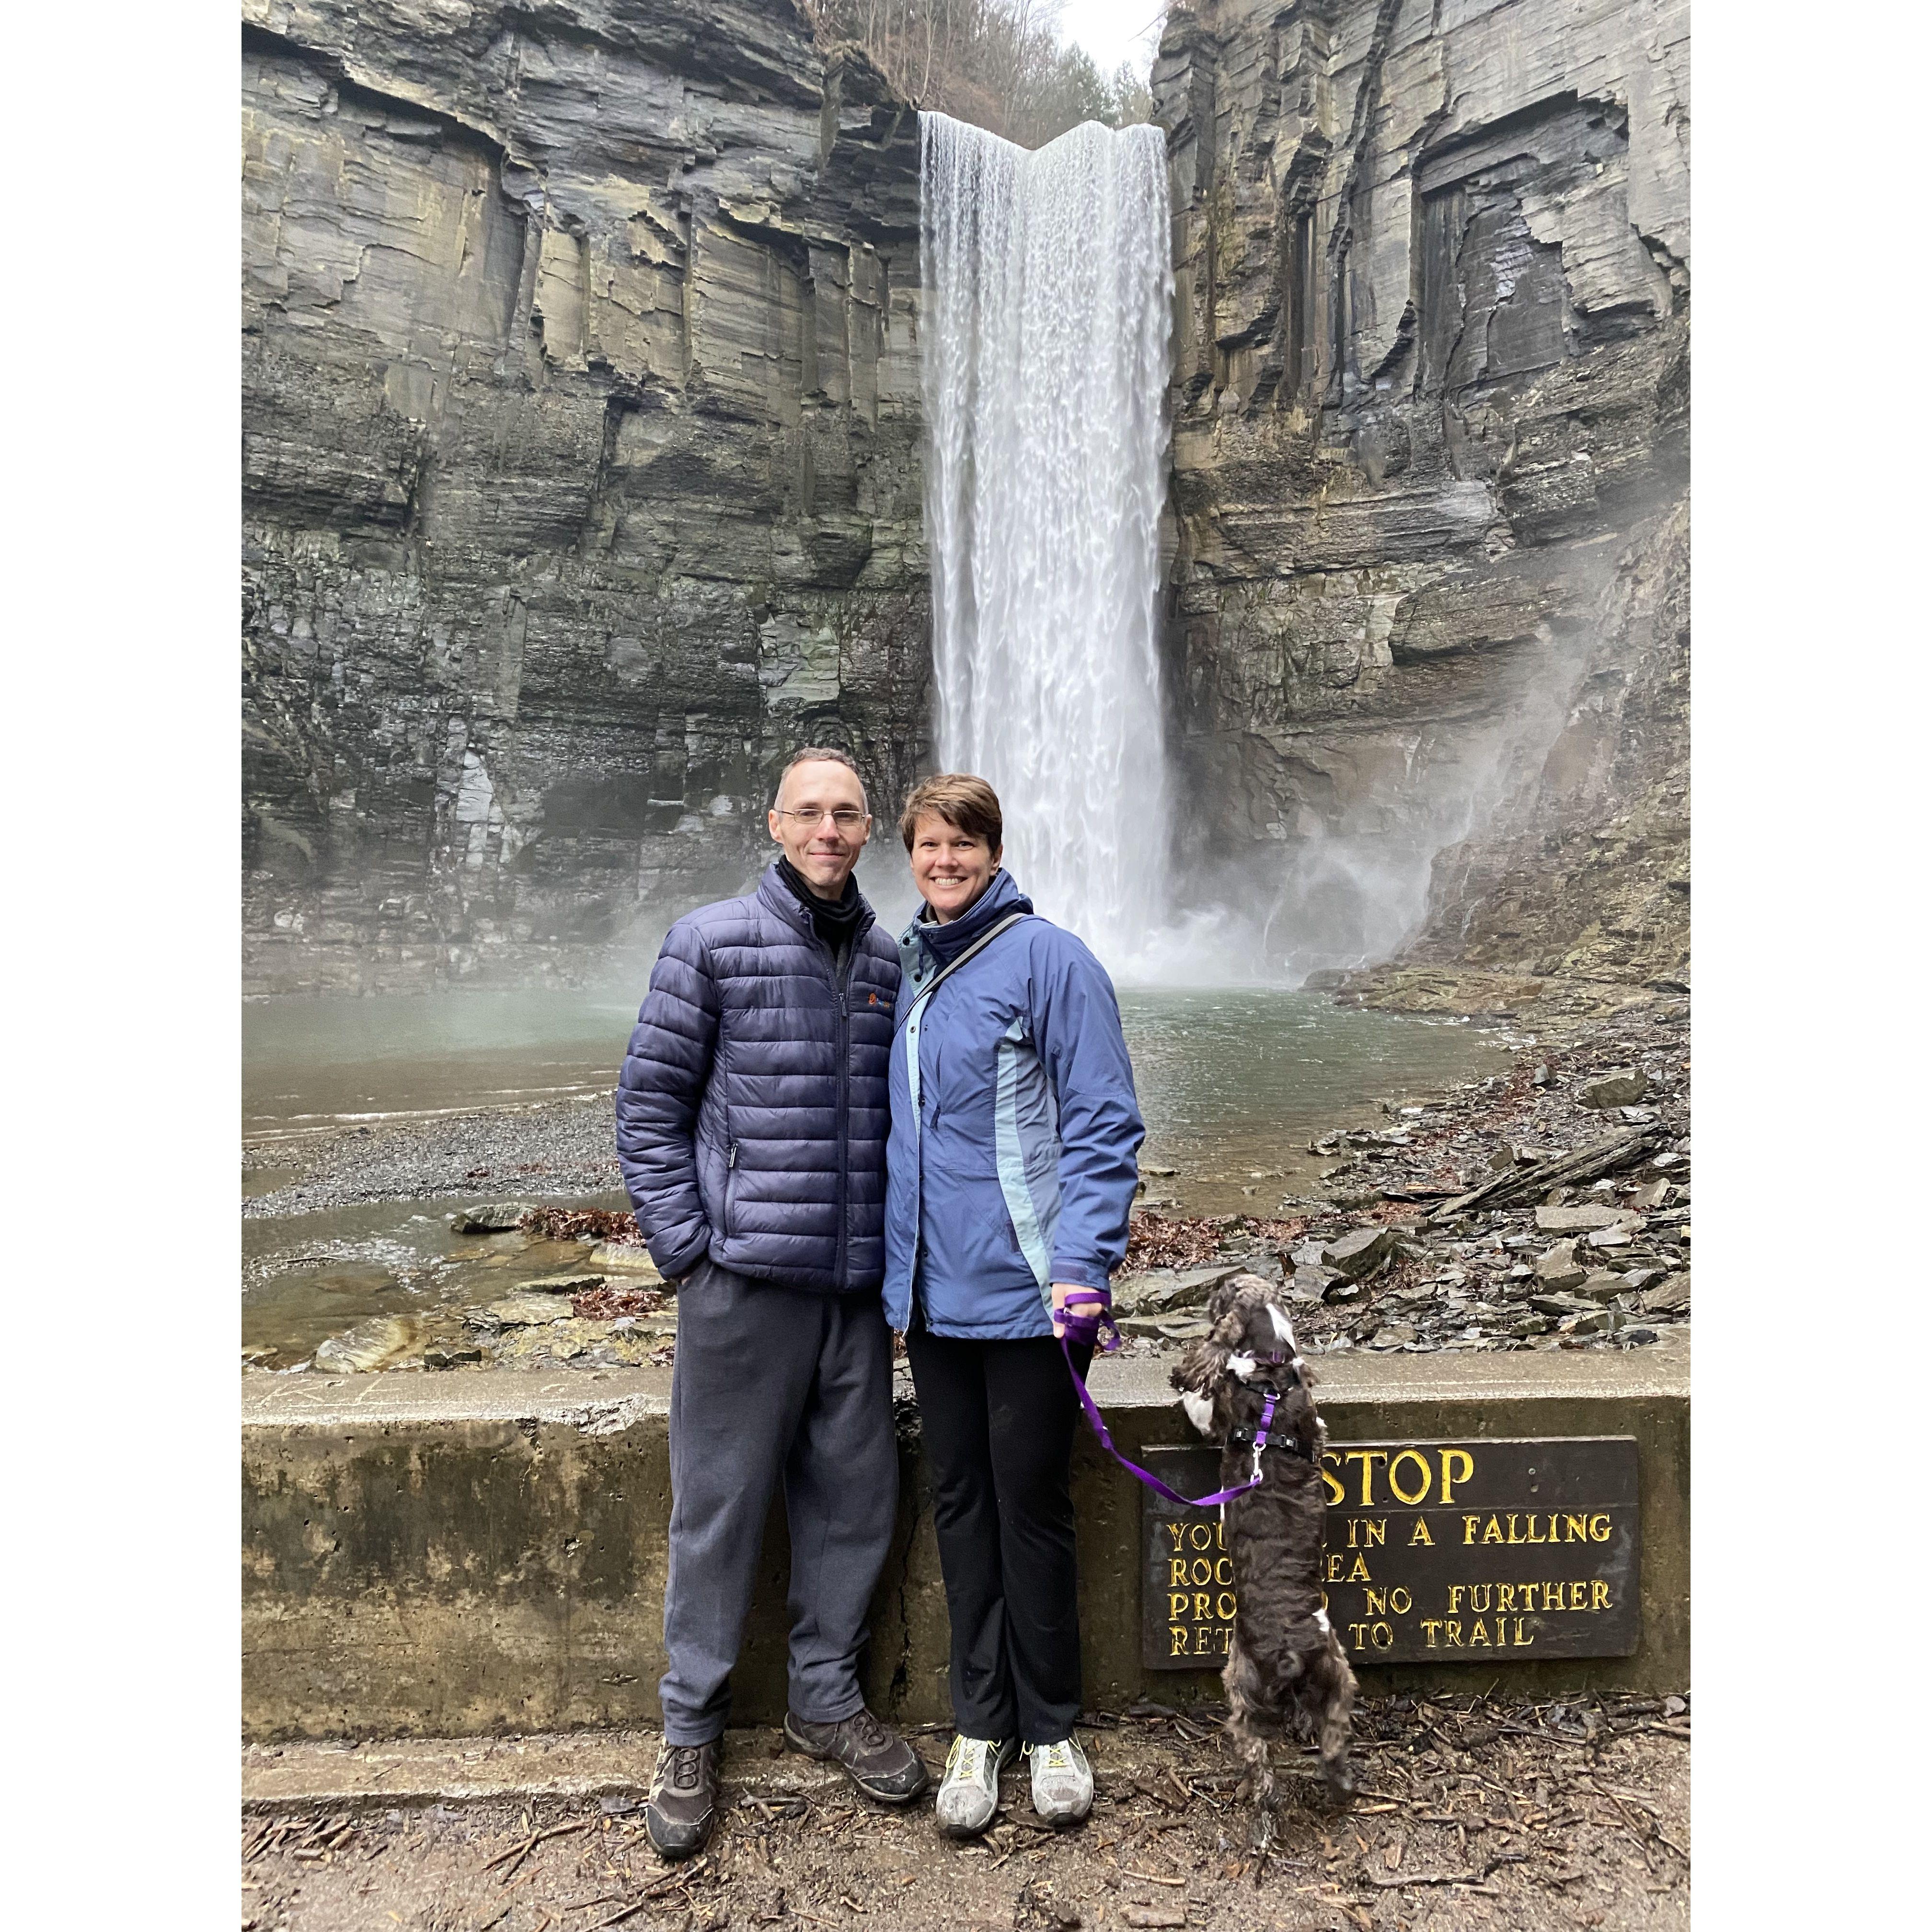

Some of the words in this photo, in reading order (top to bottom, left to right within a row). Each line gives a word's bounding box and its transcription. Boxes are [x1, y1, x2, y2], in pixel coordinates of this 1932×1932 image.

[1319, 1449, 1474, 1506] STOP
[1347, 1518, 1387, 1548] IN
[1407, 1517, 1435, 1546] A
[1462, 1513, 1613, 1545] FALLING
[1168, 1557, 1233, 1587] ROC
[1320, 1552, 1371, 1583] EA
[1363, 1586, 1412, 1616] NO
[1448, 1580, 1613, 1614] FURTHER
[1348, 1622, 1393, 1650] TO
[1420, 1617, 1534, 1649] TRAIL
